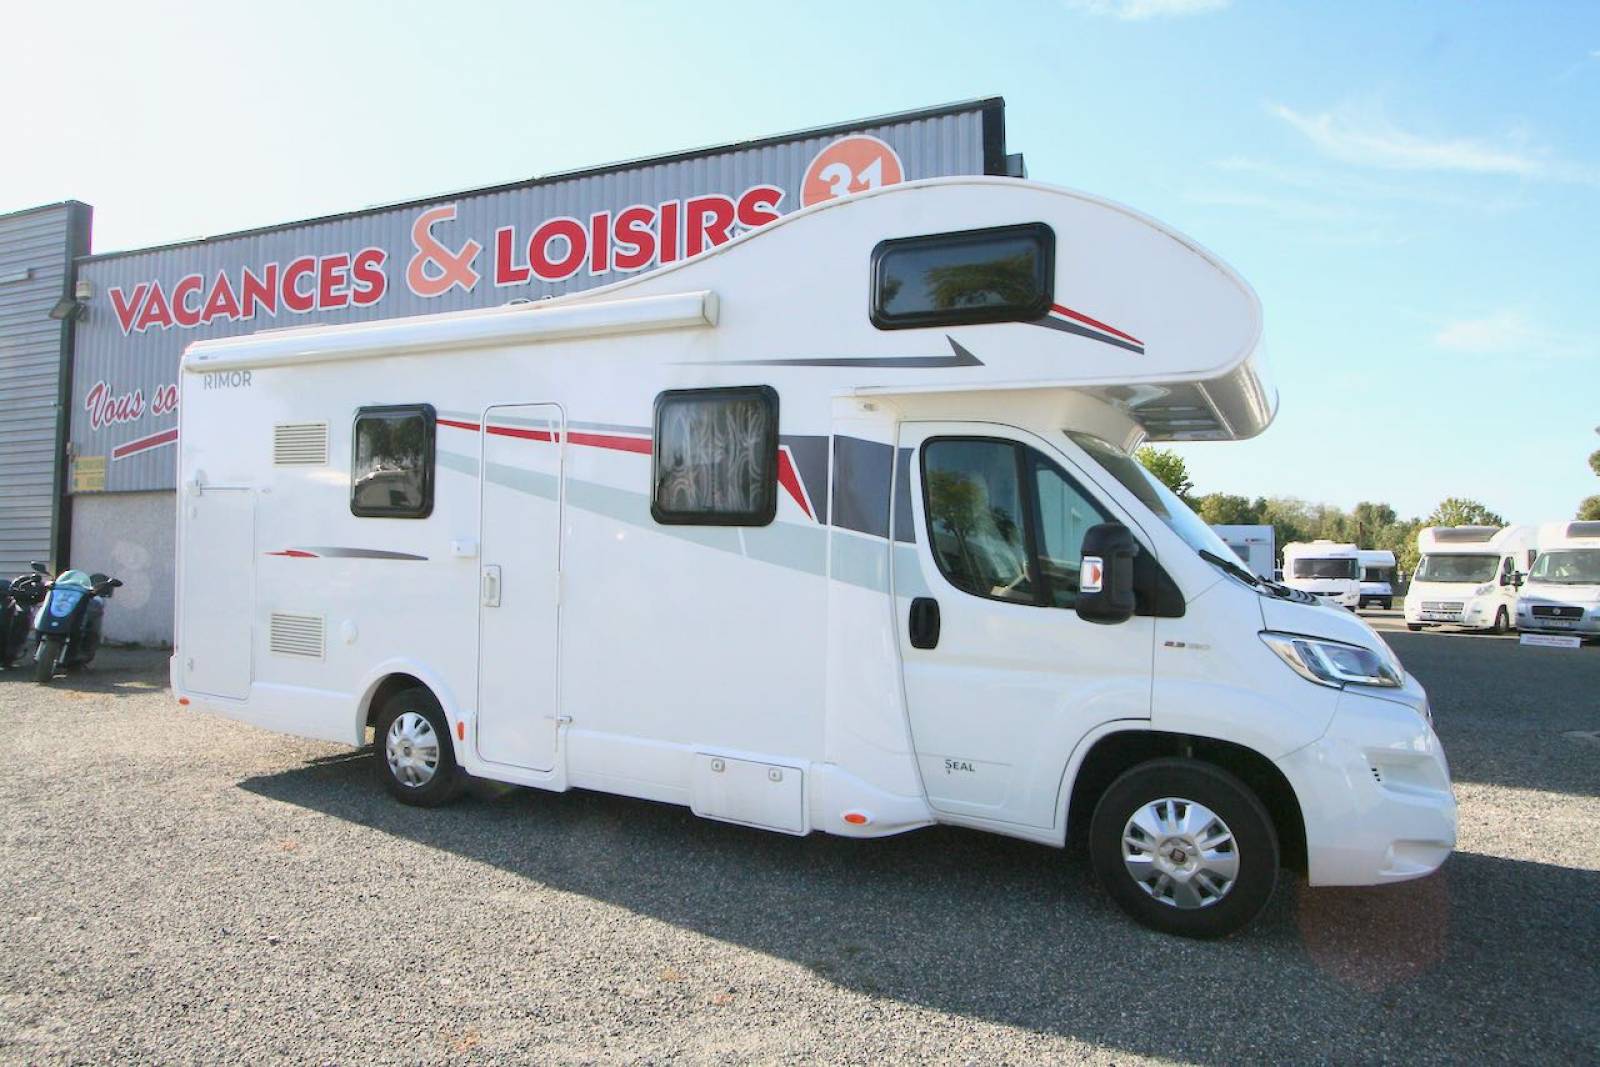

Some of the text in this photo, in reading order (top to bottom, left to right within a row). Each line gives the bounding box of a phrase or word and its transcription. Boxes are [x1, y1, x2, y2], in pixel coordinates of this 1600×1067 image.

[109, 248, 387, 335] VACANCES
[406, 205, 482, 297] &
[495, 187, 784, 285] LOISIRS
[204, 370, 252, 390] RIMOR
[85, 381, 146, 431] Vous
[944, 759, 976, 772] SEAL
